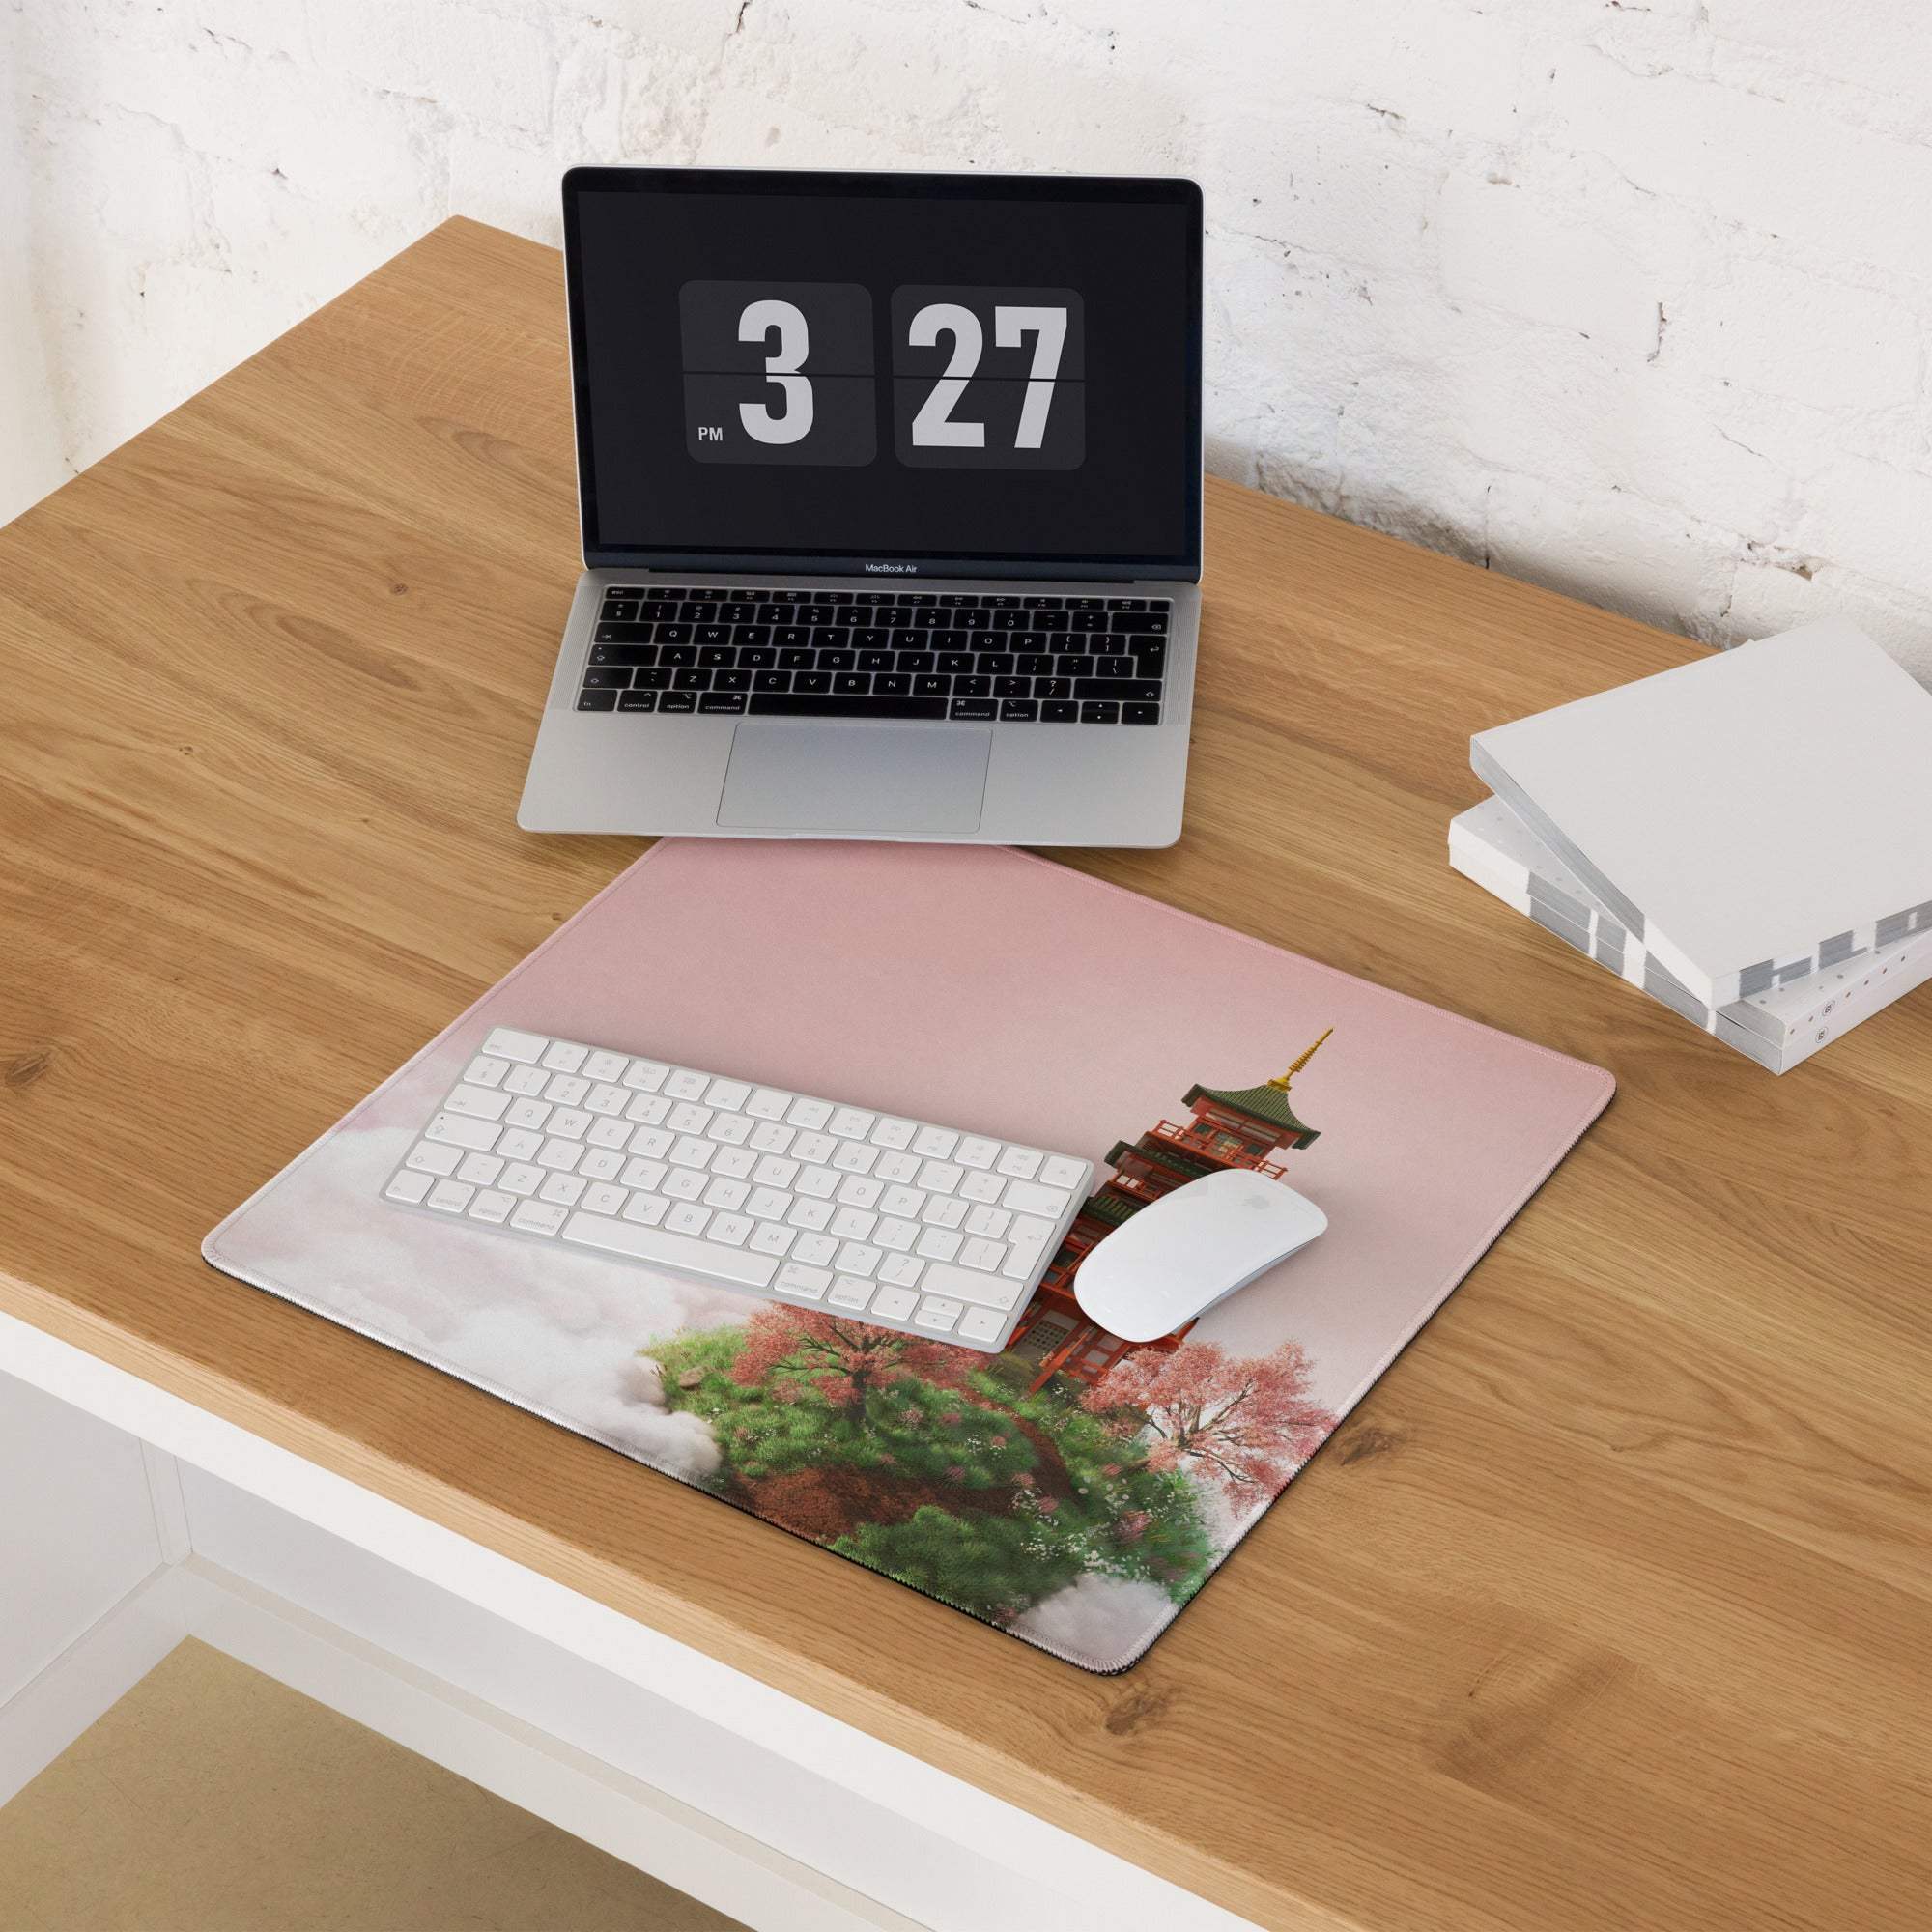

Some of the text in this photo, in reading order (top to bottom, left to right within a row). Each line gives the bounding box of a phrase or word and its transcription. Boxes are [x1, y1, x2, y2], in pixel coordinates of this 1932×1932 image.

[736, 298, 815, 446] 3
[908, 302, 1068, 450] 27
[697, 426, 724, 441] PM
[865, 563, 918, 573] MacBook Air
